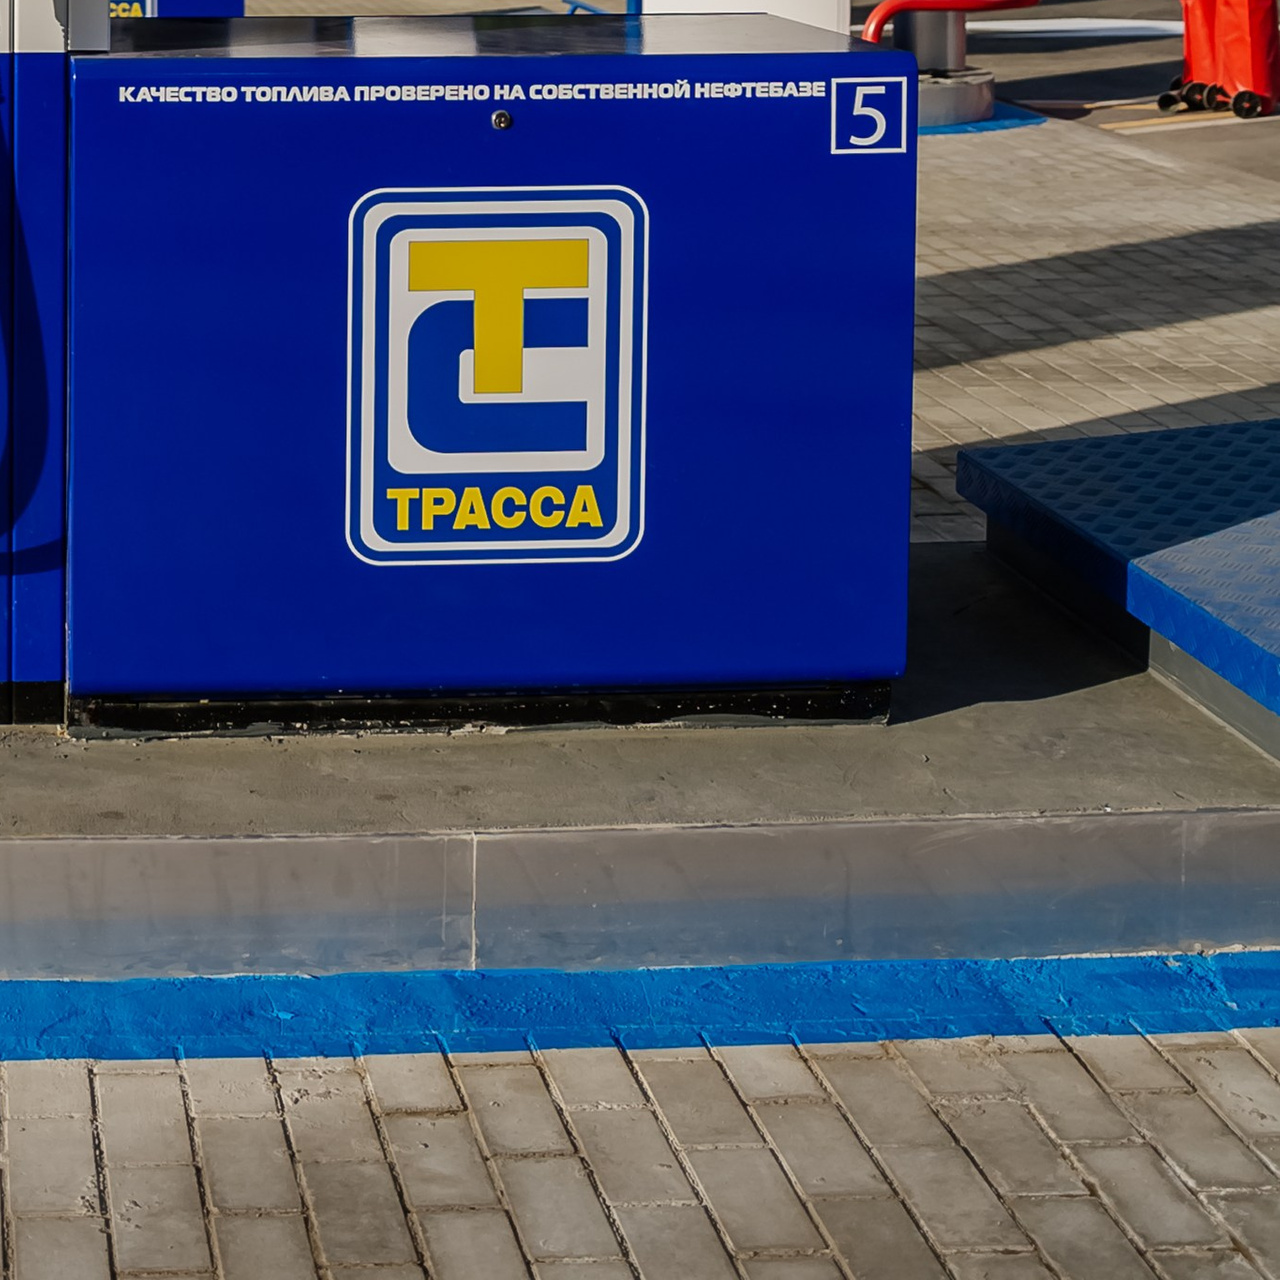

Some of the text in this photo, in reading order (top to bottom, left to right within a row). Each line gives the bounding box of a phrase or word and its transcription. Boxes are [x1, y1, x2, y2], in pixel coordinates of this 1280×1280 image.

[118, 79, 826, 103] КАЧЕСТВО ТОПЛИВА ПРОВЕРЕНО НА СОБСТВЕННОЙ НЕФТЕБАЗЕ
[849, 86, 887, 146] 5
[386, 485, 603, 530] ТРАССА
